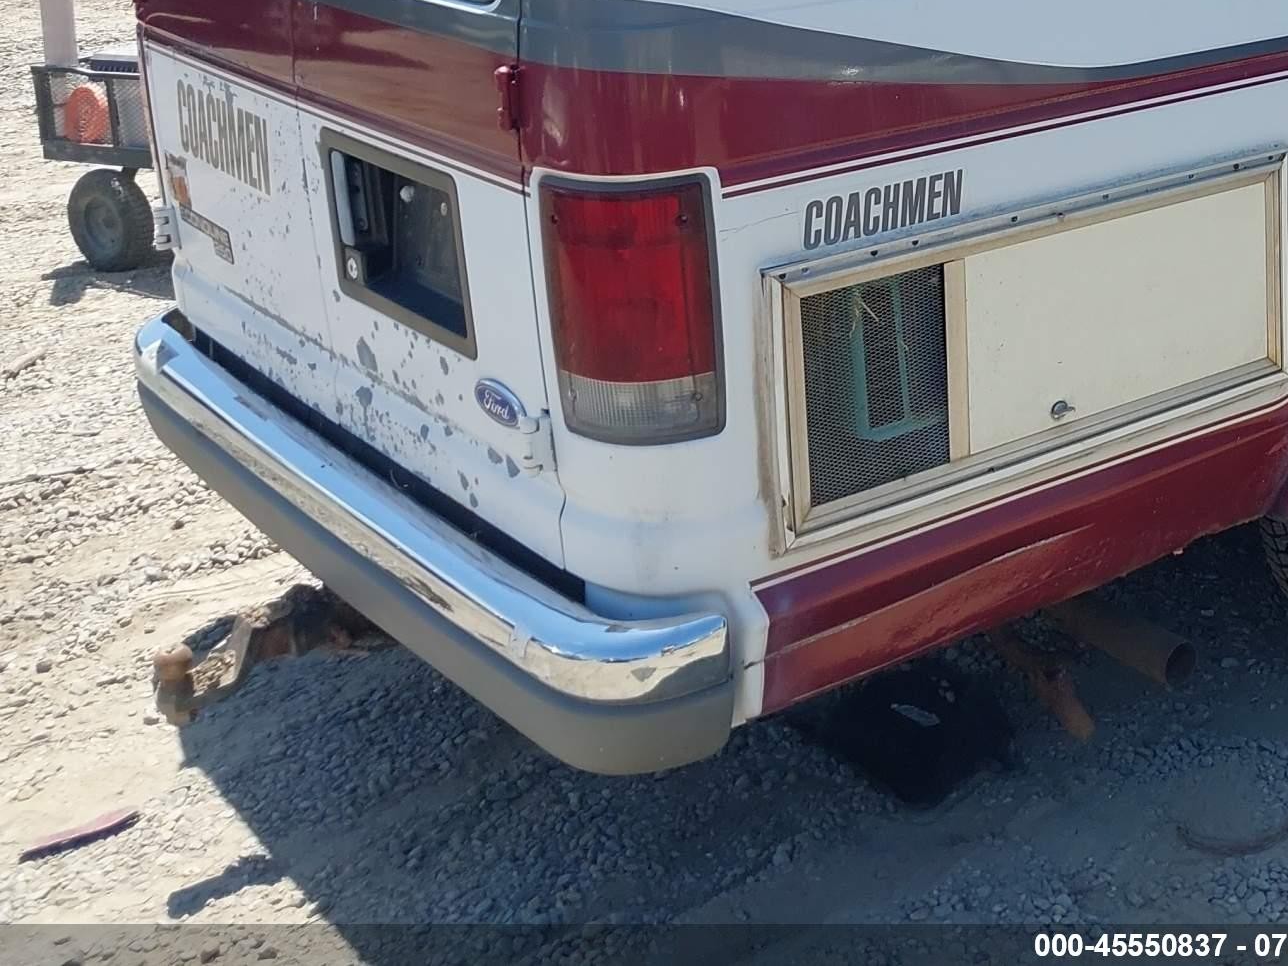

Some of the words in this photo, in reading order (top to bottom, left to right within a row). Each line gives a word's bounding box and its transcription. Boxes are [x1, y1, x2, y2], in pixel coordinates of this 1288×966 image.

[176, 79, 271, 196] COACHMEN
[803, 169, 963, 250] COACHMEN
[483, 389, 510, 420] Ford
